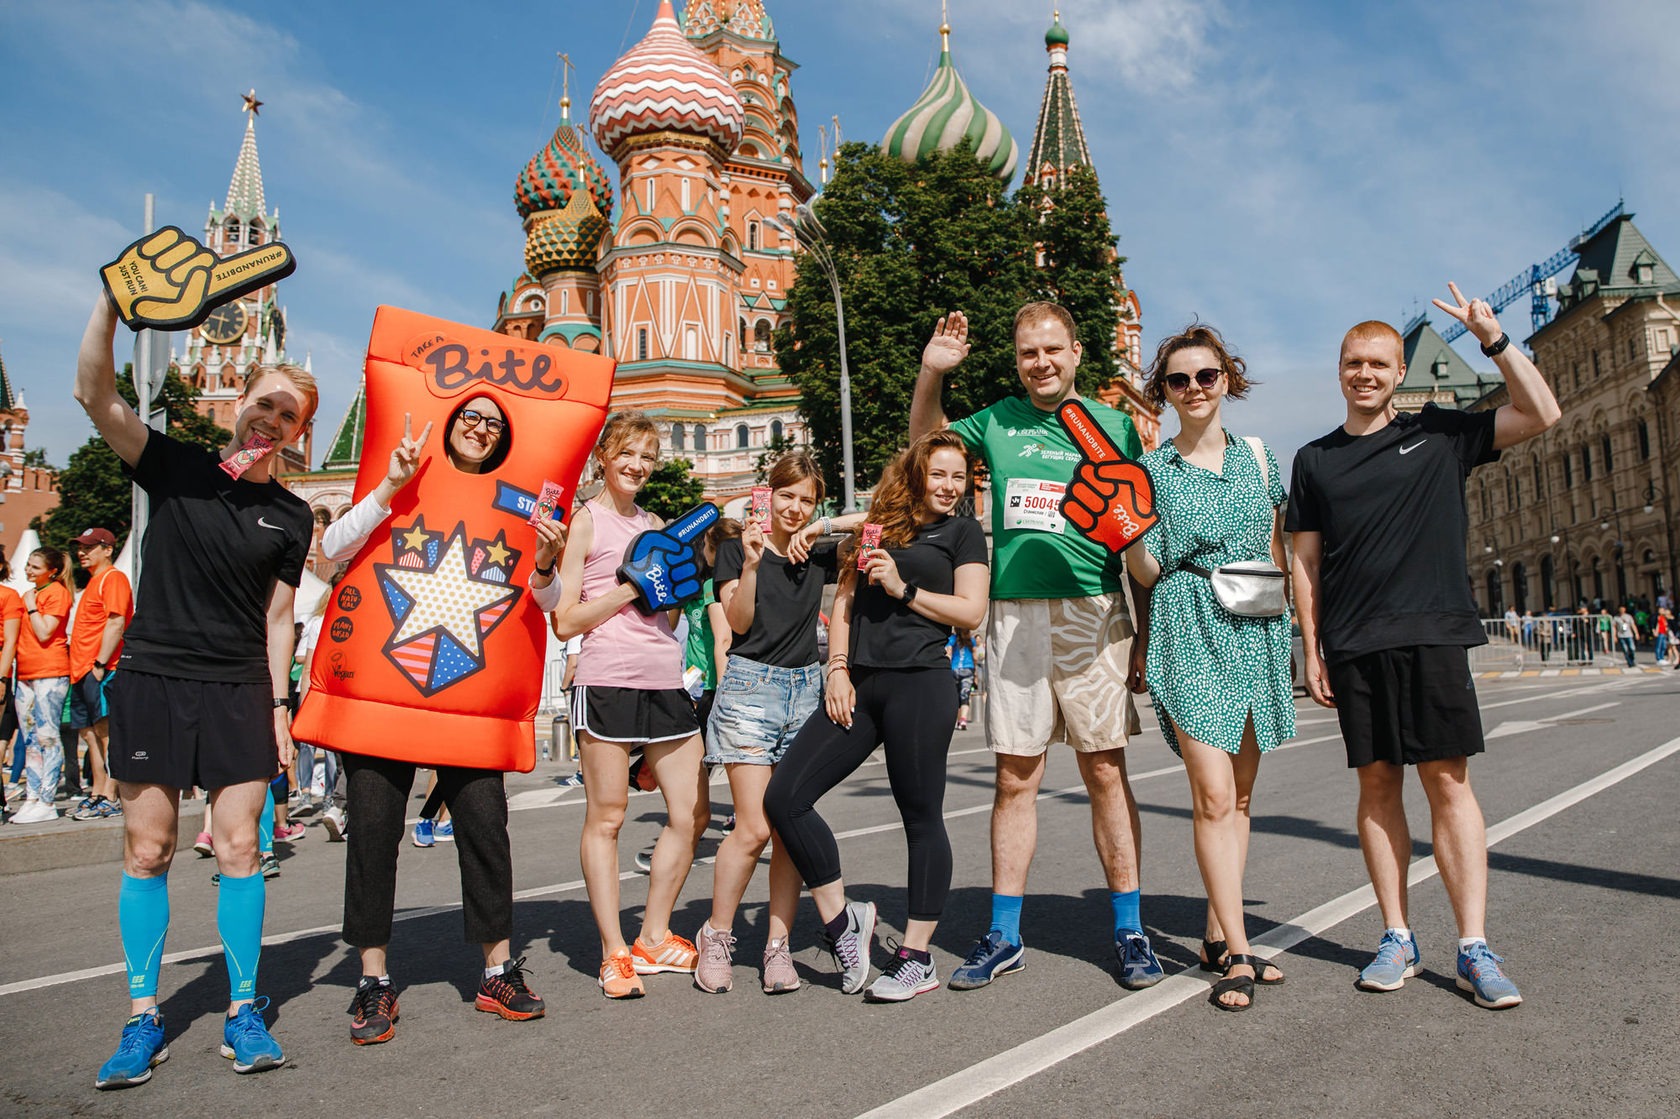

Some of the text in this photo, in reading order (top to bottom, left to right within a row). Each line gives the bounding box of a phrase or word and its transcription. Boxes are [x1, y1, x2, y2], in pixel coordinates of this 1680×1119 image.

[118, 265, 139, 296] JUST RUN
[129, 260, 150, 293] YOU CAN!
[215, 250, 283, 282] #RUNANDBITE
[410, 335, 445, 358] TAKE A
[425, 344, 563, 393] Bite
[1065, 407, 1107, 459] #RUNANDBITE
[1024, 495, 1060, 512] 50045
[677, 508, 715, 538] #RUNANDBITE
[1113, 503, 1139, 538] Bite
[645, 566, 667, 602] Bite
